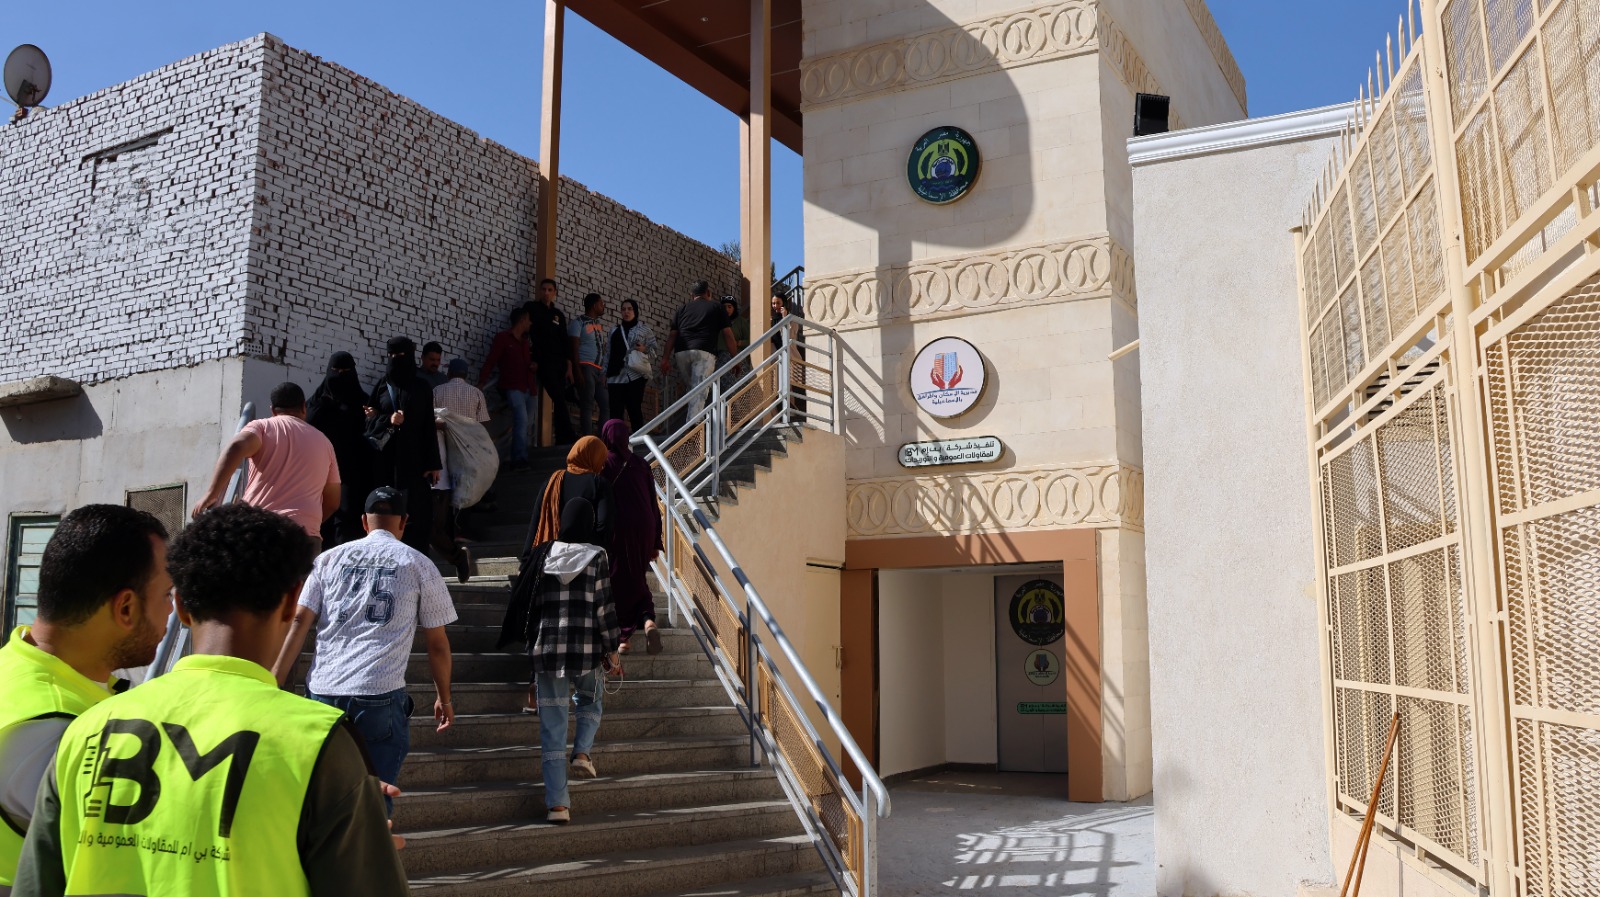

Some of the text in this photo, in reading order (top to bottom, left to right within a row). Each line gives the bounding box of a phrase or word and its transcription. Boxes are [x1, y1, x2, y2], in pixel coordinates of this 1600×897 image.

[938, 131, 949, 140] مصر
[946, 441, 973, 452] شركة
[965, 450, 994, 460] للمقاولات
[938, 453, 965, 462] العمومية
[340, 566, 398, 627] 75
[98, 718, 260, 838] BM
[96, 832, 139, 849] العمومية
[141, 836, 179, 854] للمقاولات
[210, 845, 231, 863] شركة
